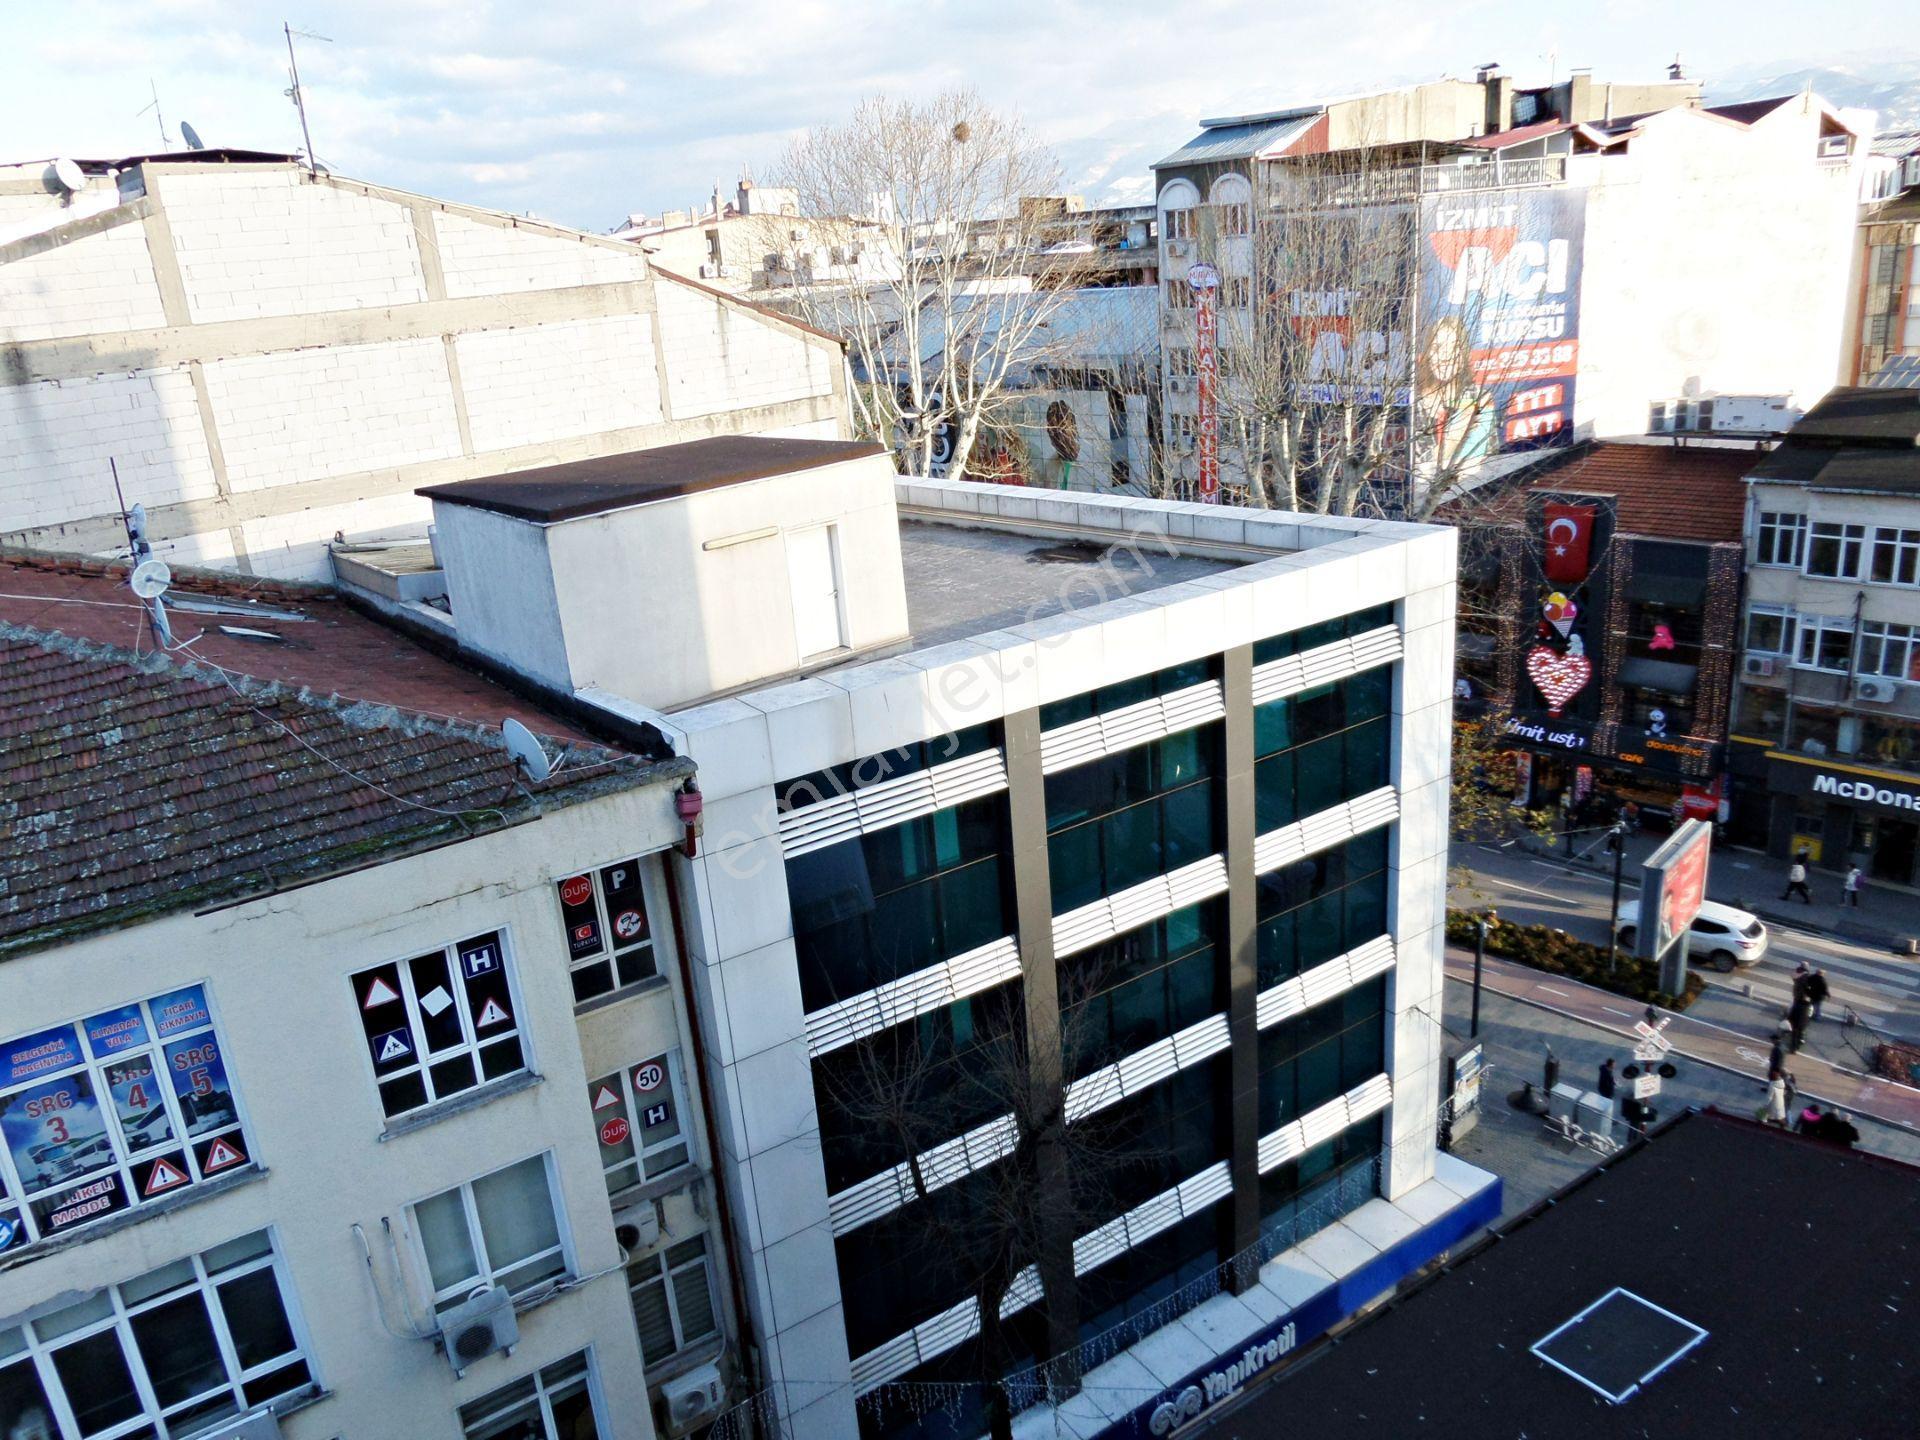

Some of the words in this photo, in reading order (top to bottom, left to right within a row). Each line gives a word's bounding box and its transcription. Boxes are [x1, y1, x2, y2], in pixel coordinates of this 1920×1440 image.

[1619, 751, 1645, 764] cafe
[612, 869, 626, 889] P
[564, 882, 589, 898] DUR
[470, 950, 489, 972] H
[105, 1034, 132, 1049] YOLA
[174, 1043, 217, 1071] SRC
[189, 1068, 214, 1097] 5
[639, 1067, 660, 1087] 50
[25, 1091, 72, 1120] SRC
[128, 1083, 149, 1110] 4
[648, 1105, 665, 1125] H
[46, 1116, 71, 1145] 3
[603, 1124, 626, 1139] DUR
[51, 1196, 111, 1228] MADDE
